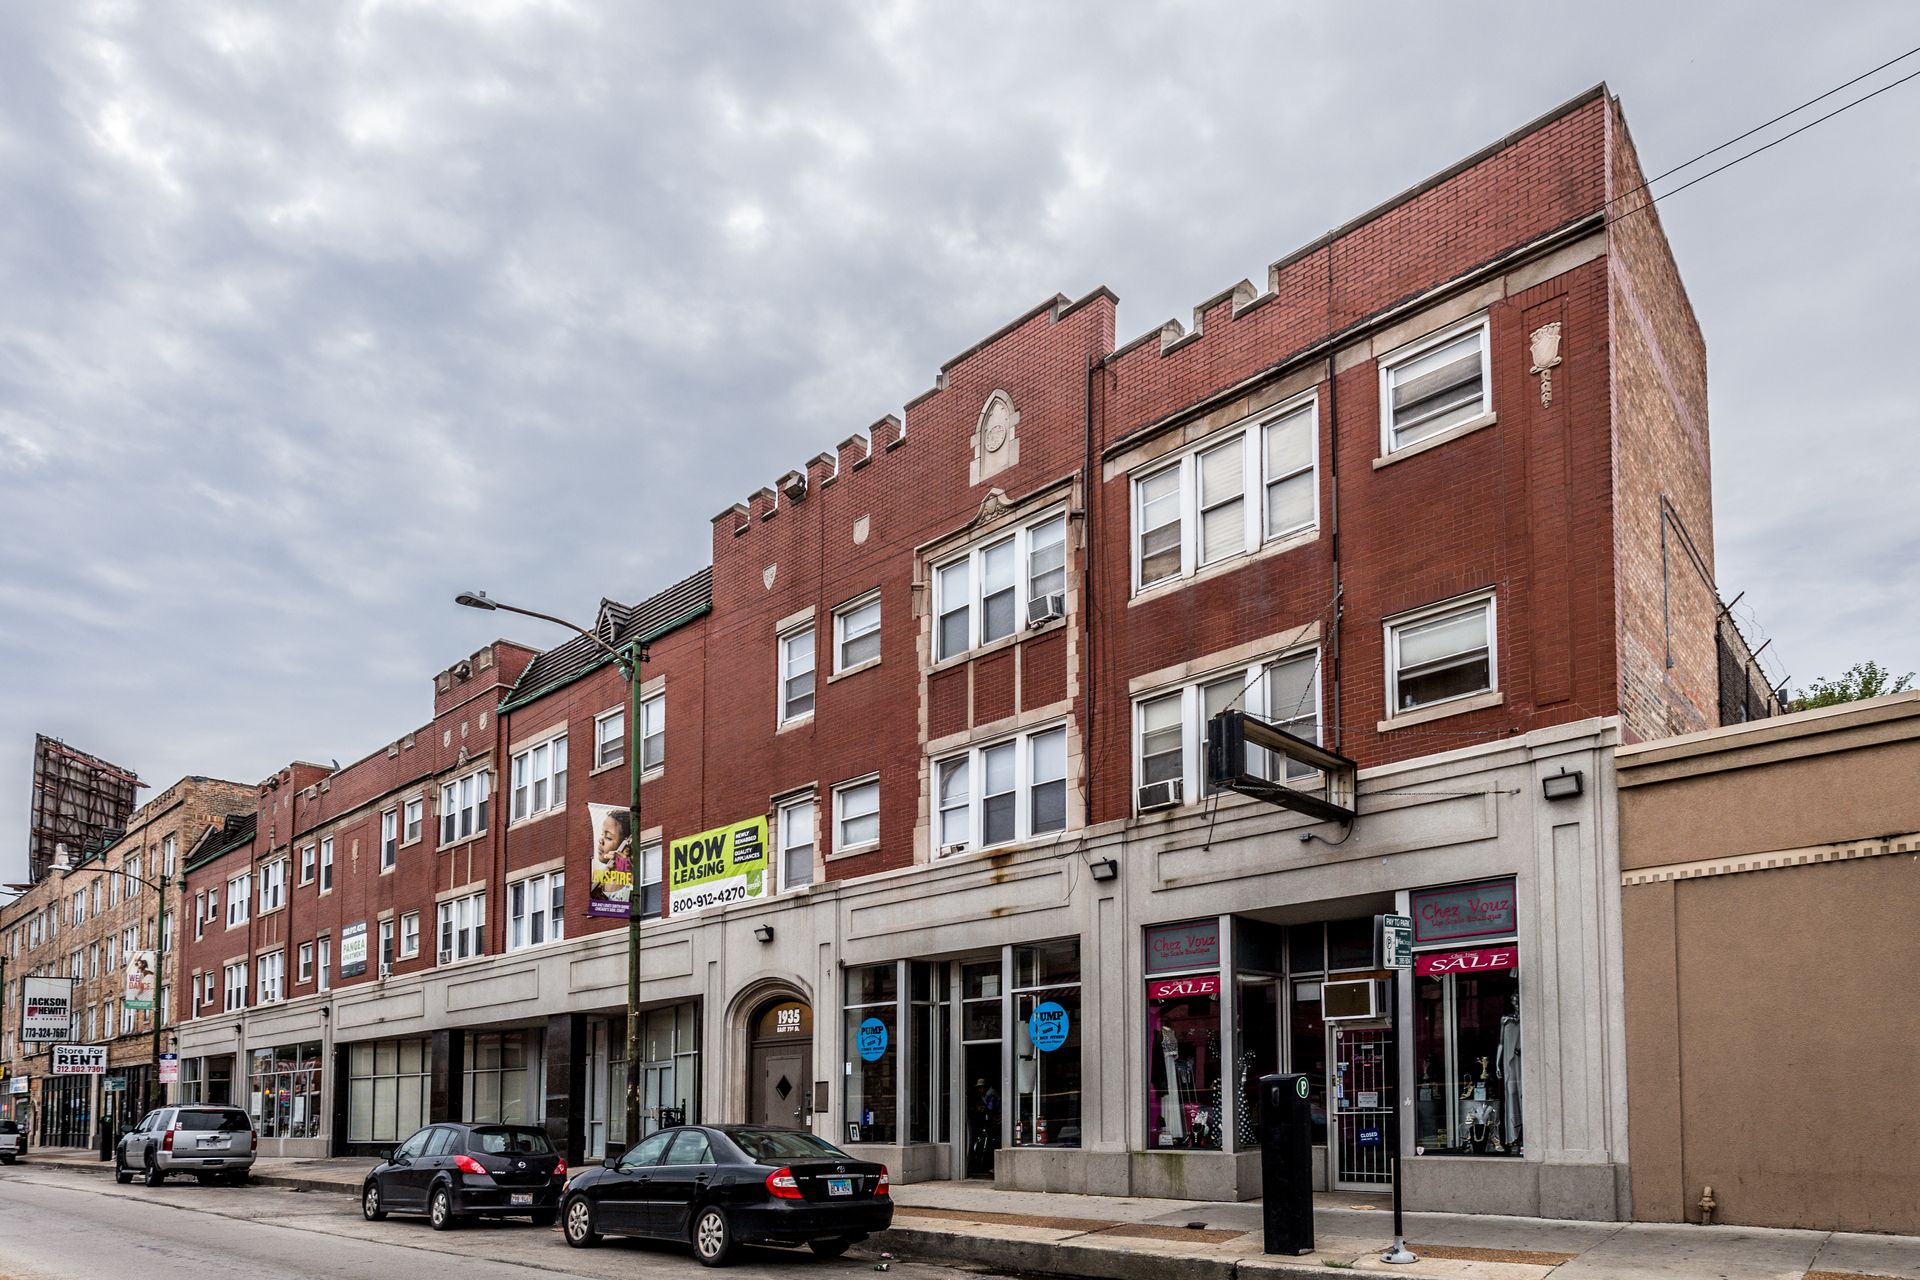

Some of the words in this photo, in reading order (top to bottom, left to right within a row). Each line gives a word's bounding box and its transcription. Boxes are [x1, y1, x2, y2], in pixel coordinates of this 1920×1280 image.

[735, 831, 750, 839] NEWLY
[735, 835, 757, 845] REHABBED
[674, 834, 726, 870] NOW
[734, 852, 760, 862] APPLIANCES
[735, 848, 752, 856] QUALITY
[615, 857, 630, 871] WE
[593, 870, 632, 885] INSPIRE
[674, 860, 724, 885] LEASING
[673, 886, 745, 912] 800-912-4270
[1422, 902, 1460, 920] Chez
[1468, 898, 1509, 913] Vouz
[1400, 919, 1410, 927] PARK
[343, 940, 364, 953] PANGEA
[1153, 936, 1181, 952] Chez
[1186, 935, 1216, 948] Vouz
[1430, 953, 1509, 972] SALE
[1158, 982, 1214, 996] SALE
[28, 998, 67, 1006] JACKSON
[778, 1009, 800, 1024] 1935
[25, 1028, 68, 1038] 773-324-7667
[861, 1026, 883, 1035] PUMP
[58, 1055, 102, 1065] RENT
[1301, 1081, 1306, 1095] P
